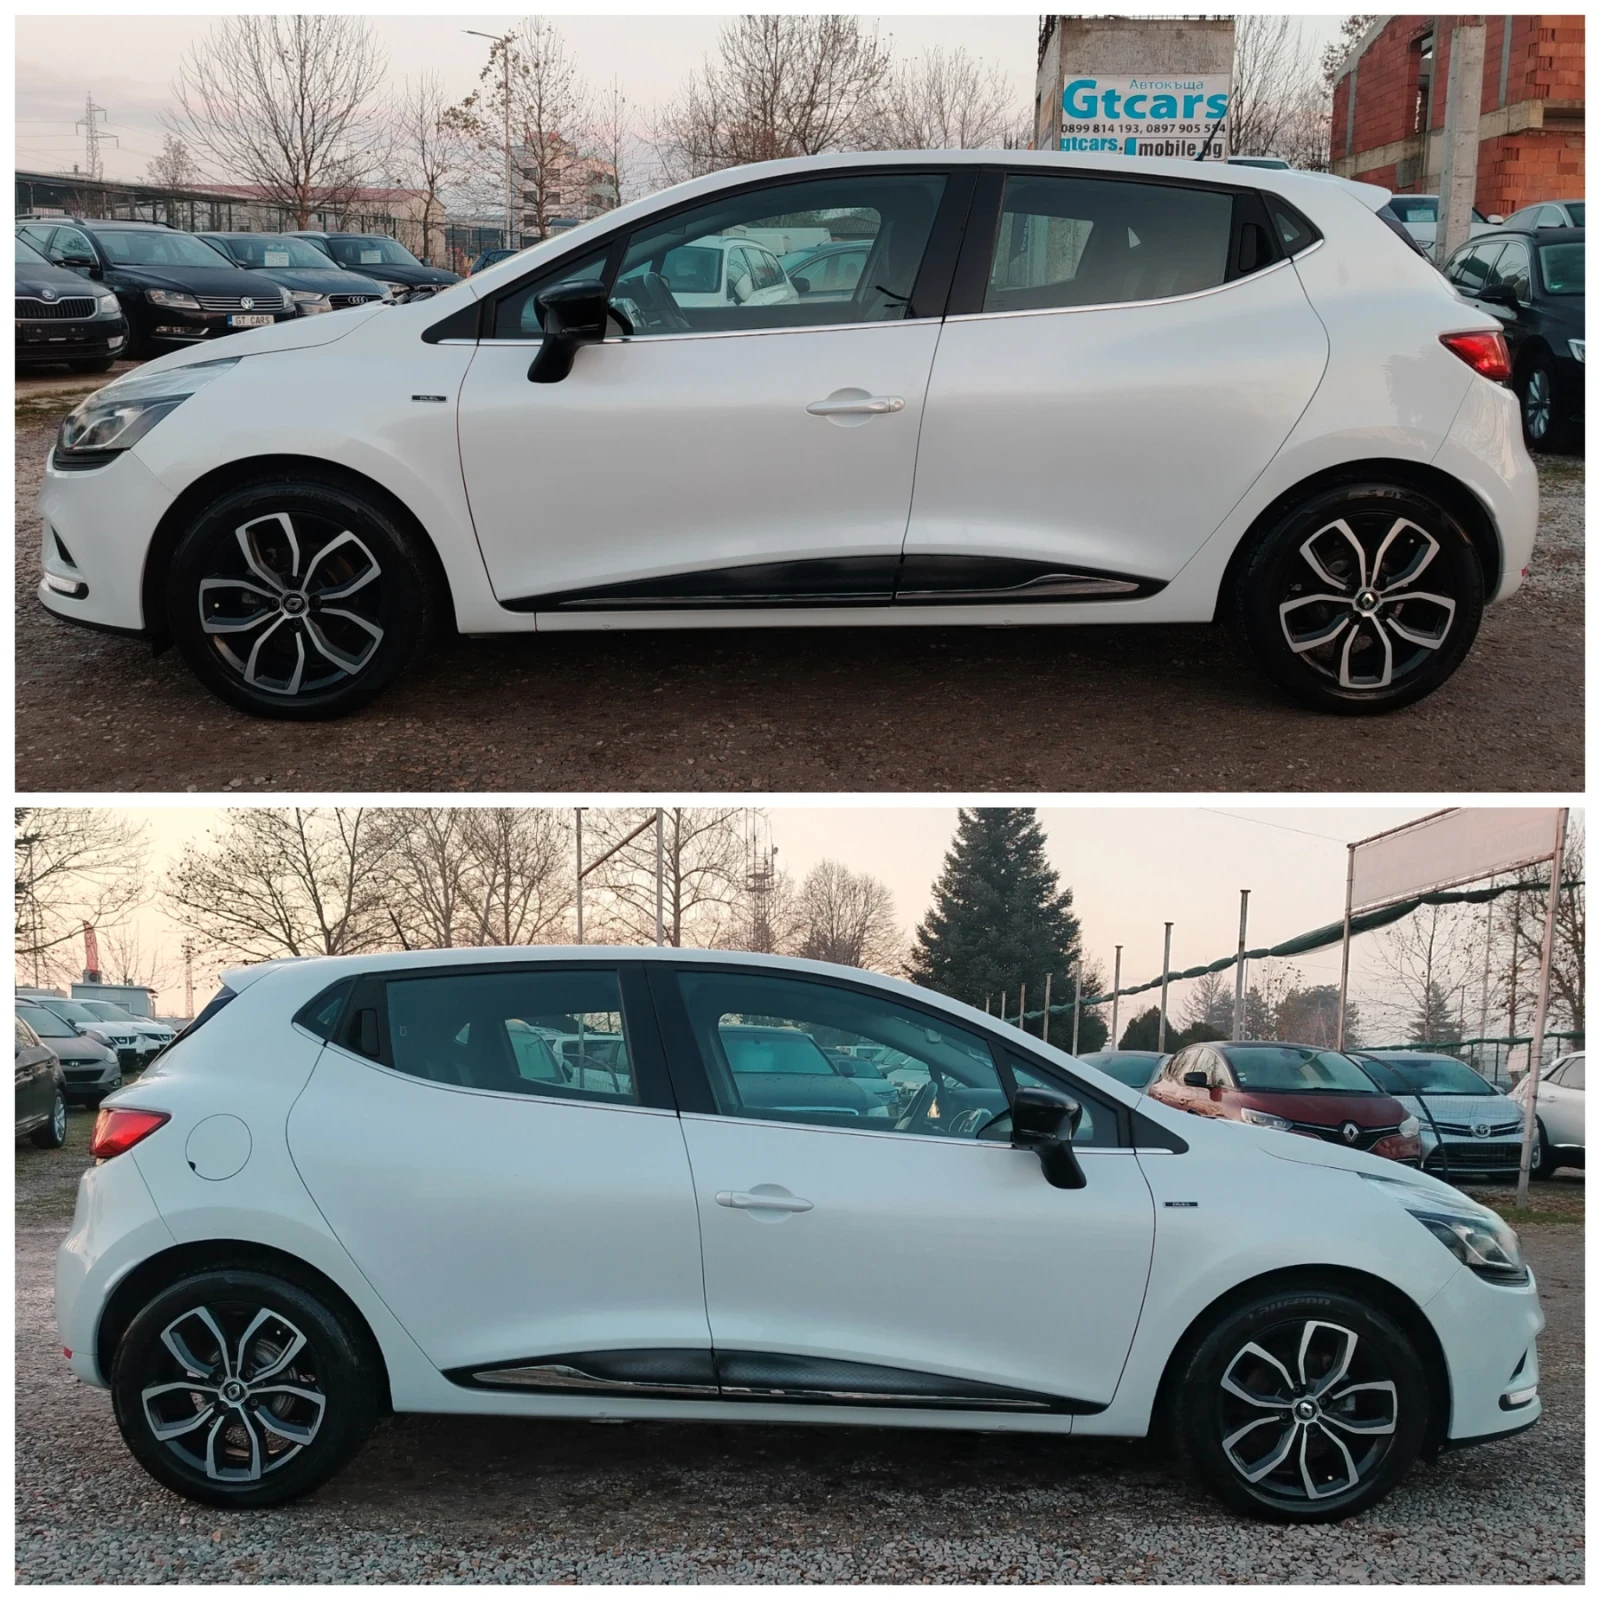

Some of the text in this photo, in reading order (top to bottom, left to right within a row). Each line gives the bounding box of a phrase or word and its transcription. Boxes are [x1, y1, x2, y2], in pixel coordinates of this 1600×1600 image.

[1129, 79, 1204, 91] Автокъща
[1063, 79, 1229, 120] Gtcars
[1061, 123, 1090, 134] 0899
[1092, 123, 1115, 134] 814
[1118, 123, 1144, 135] 193,
[1146, 123, 1176, 134] 0897
[1178, 123, 1201, 134] 905
[235, 316, 271, 325] GT CARS
